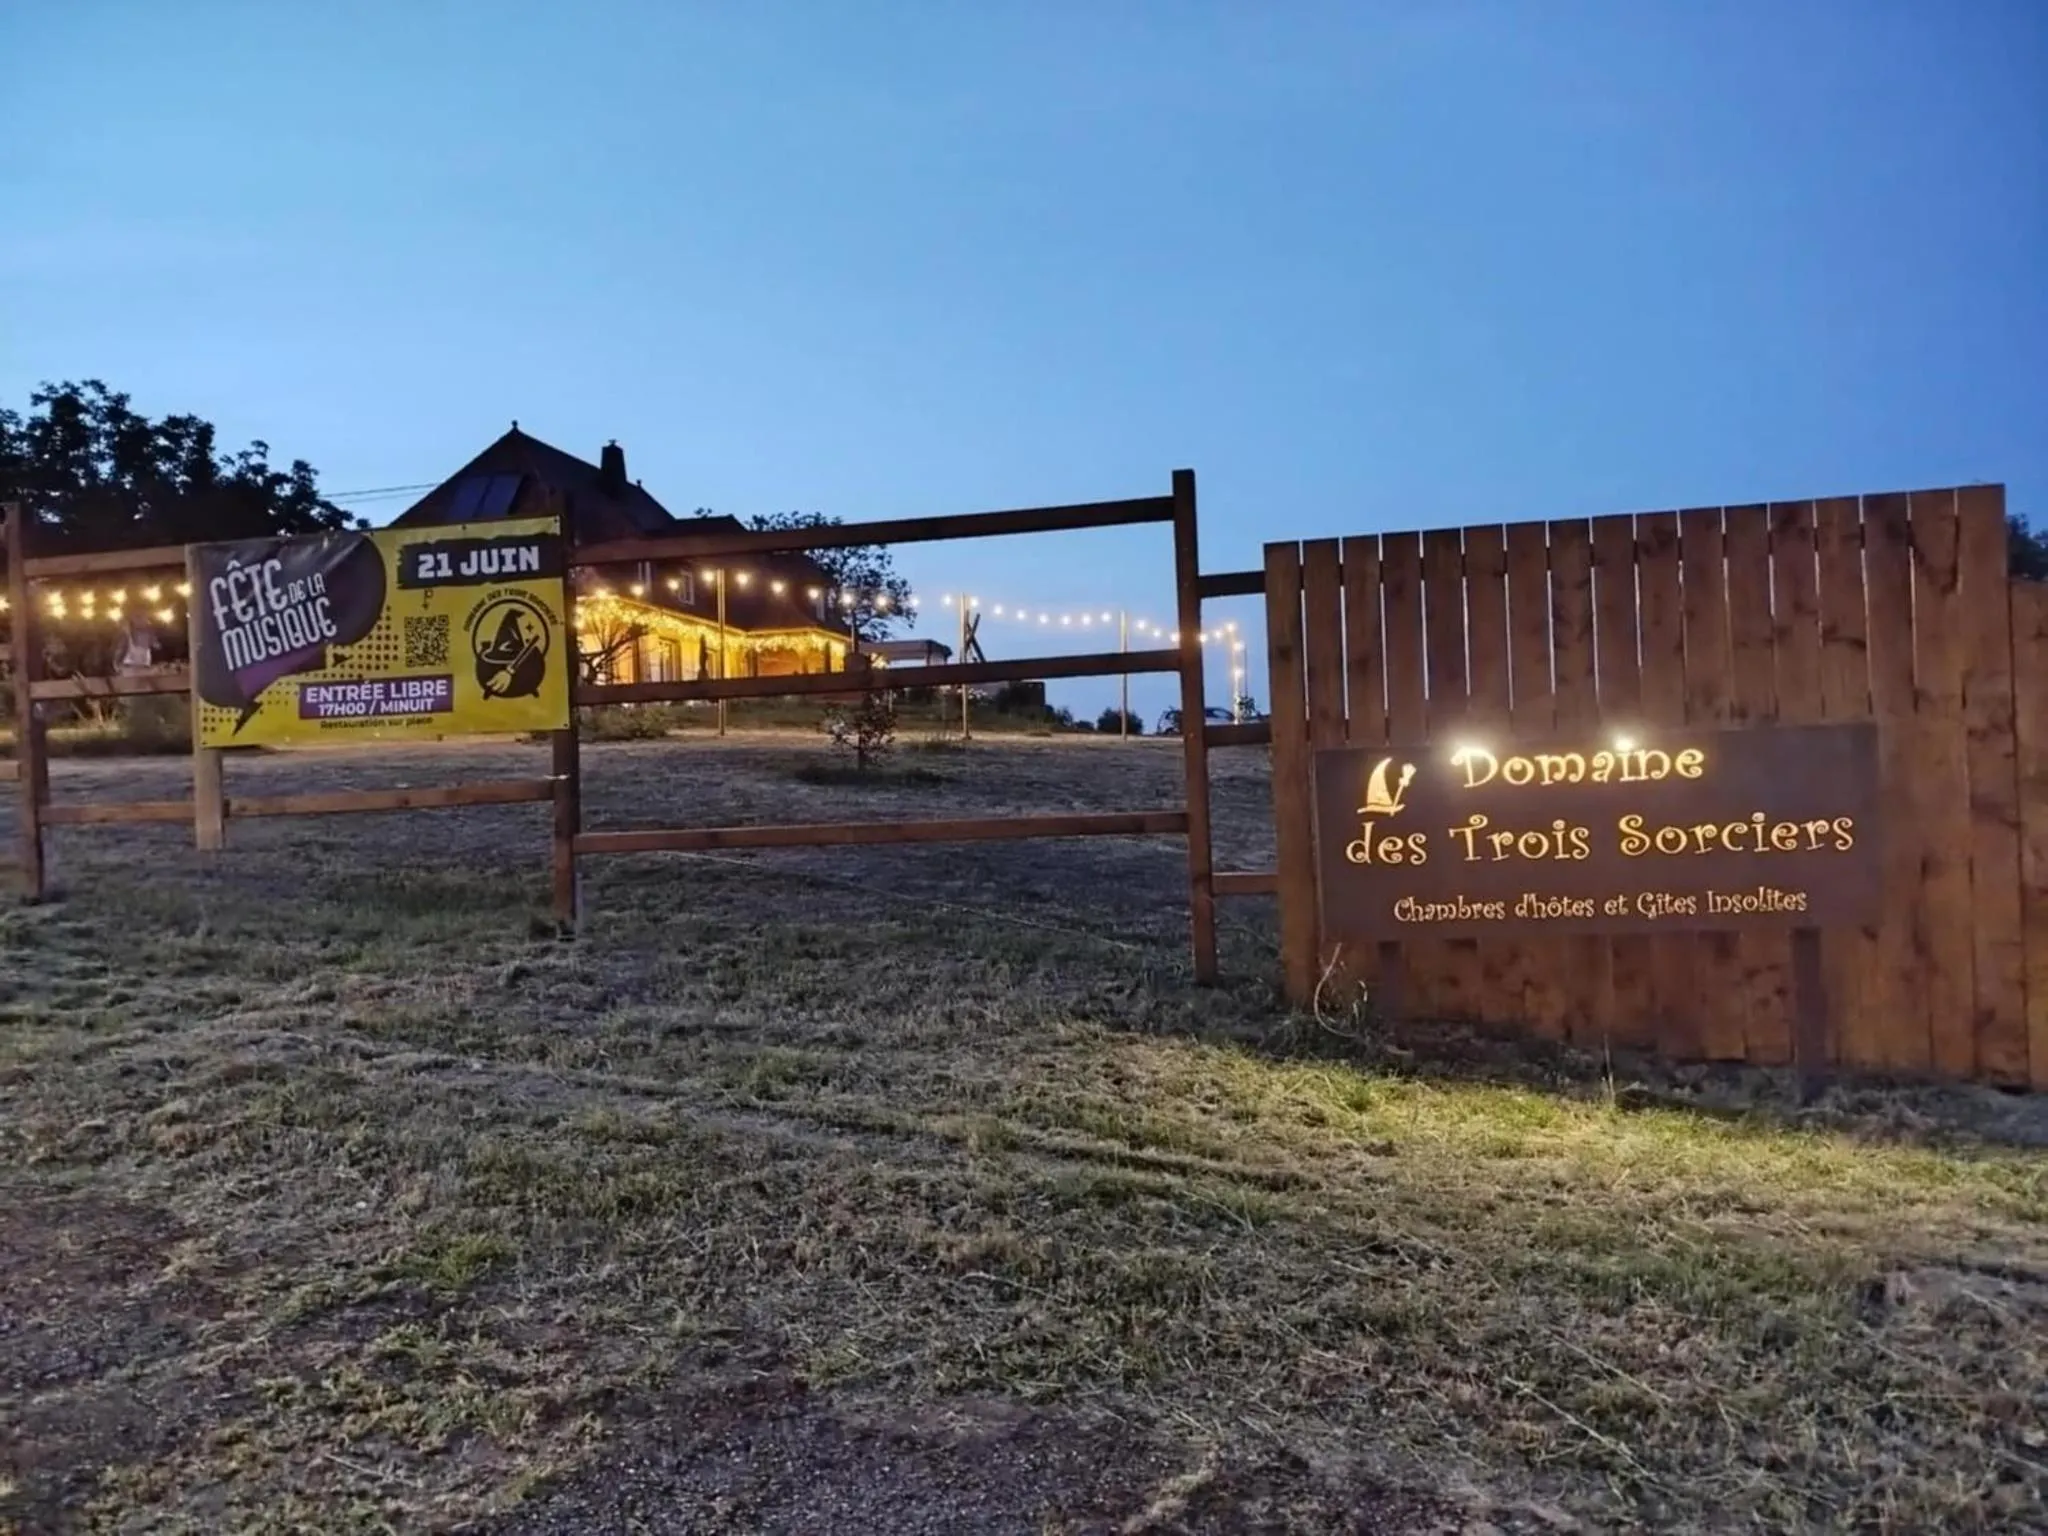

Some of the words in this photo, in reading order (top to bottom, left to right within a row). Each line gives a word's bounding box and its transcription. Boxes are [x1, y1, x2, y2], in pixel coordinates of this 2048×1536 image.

[418, 552, 453, 579] 21
[460, 546, 540, 576] JUIN
[209, 559, 288, 631] FÊTE
[288, 579, 307, 604] DE
[307, 572, 326, 597] LA
[222, 597, 337, 671] MUSIQUE
[306, 680, 384, 703] ENTRÉE
[390, 679, 448, 698] LIBRE
[318, 701, 366, 716] 17H00
[380, 698, 435, 714] MINUIT
[320, 716, 386, 729] Restauration
[405, 715, 434, 727] place
[1450, 738, 1705, 788] Domaine
[1345, 821, 1428, 864] des
[1448, 814, 1591, 862] Trois
[1618, 811, 1855, 858] Sorciers
[1393, 895, 1506, 921] Chambres
[1604, 894, 1629, 916] et
[1637, 891, 1698, 920] Gîtes
[1707, 886, 1808, 913] Insolites
